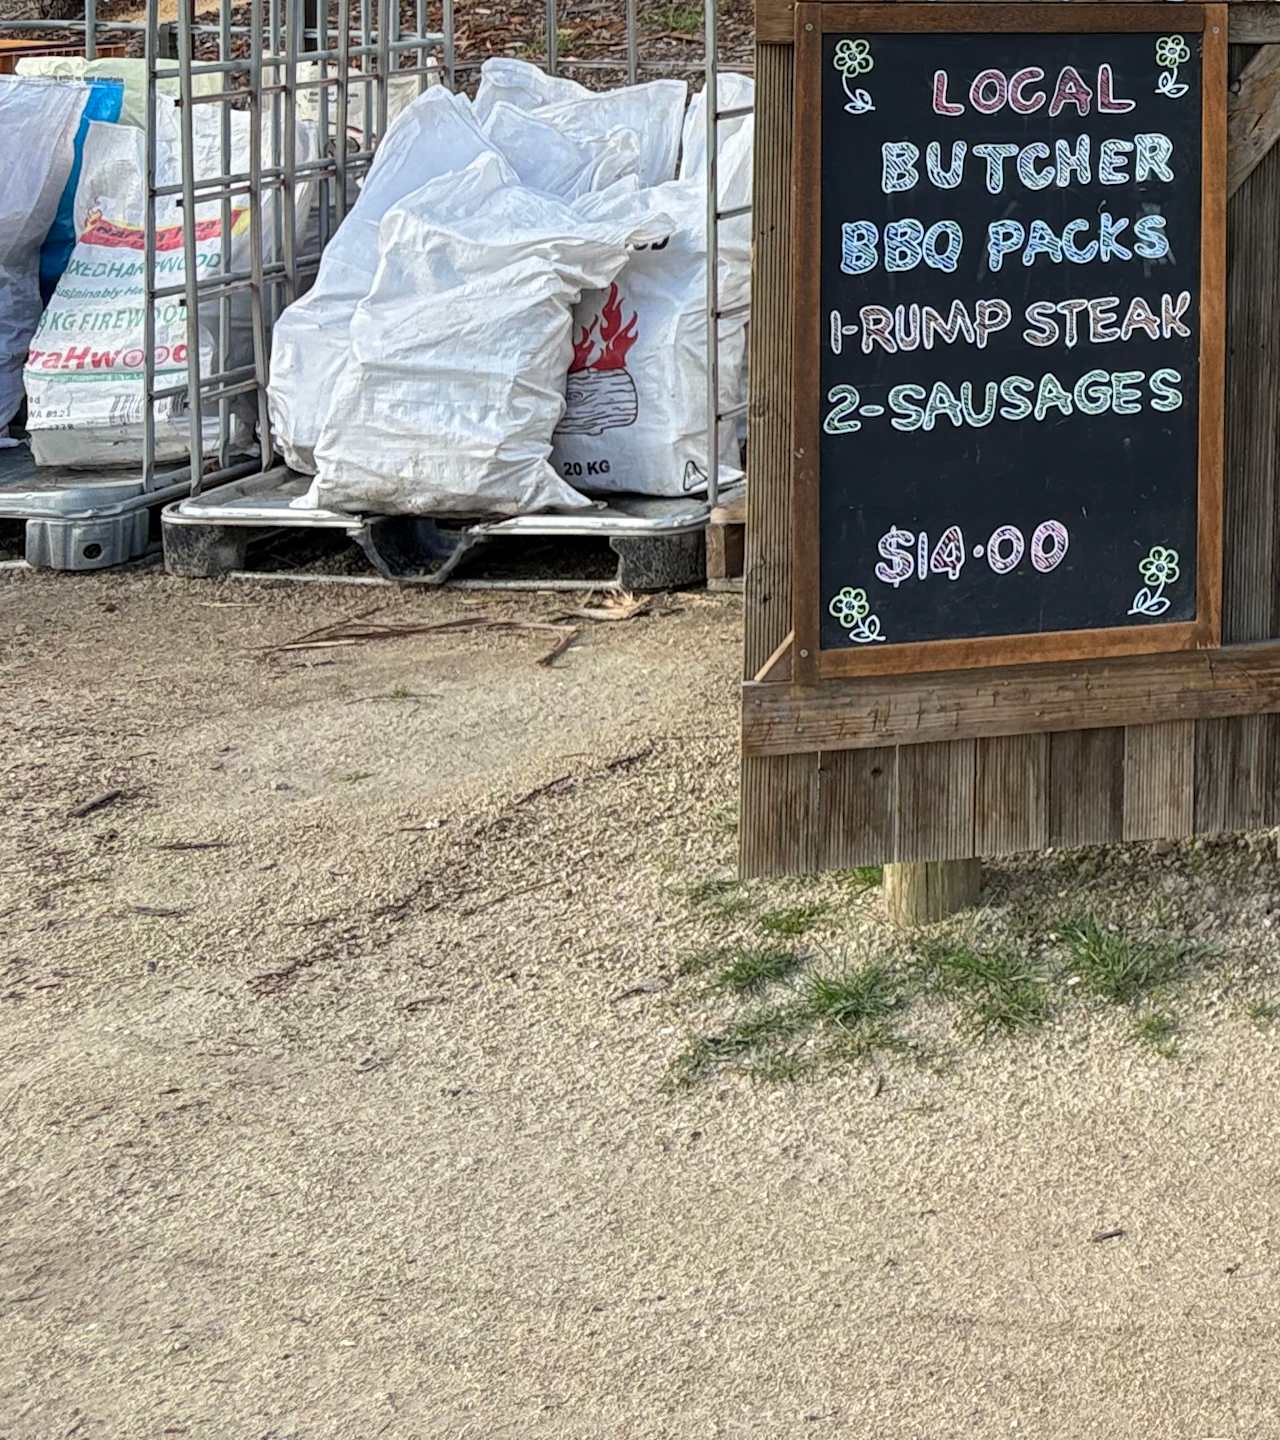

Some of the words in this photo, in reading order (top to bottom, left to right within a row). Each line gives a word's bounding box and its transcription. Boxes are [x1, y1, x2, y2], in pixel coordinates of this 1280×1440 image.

[932, 63, 1135, 117] LOCAL
[881, 132, 1175, 194] BUTCHER
[840, 217, 964, 275] BBQ
[987, 213, 1170, 272] PACKS
[830, 298, 1012, 356] 1-RUMP
[1023, 290, 1192, 350] STEAK
[823, 366, 1183, 435] 2-SAUSAGES
[563, 462, 583, 476] 20
[587, 460, 610, 475] KG
